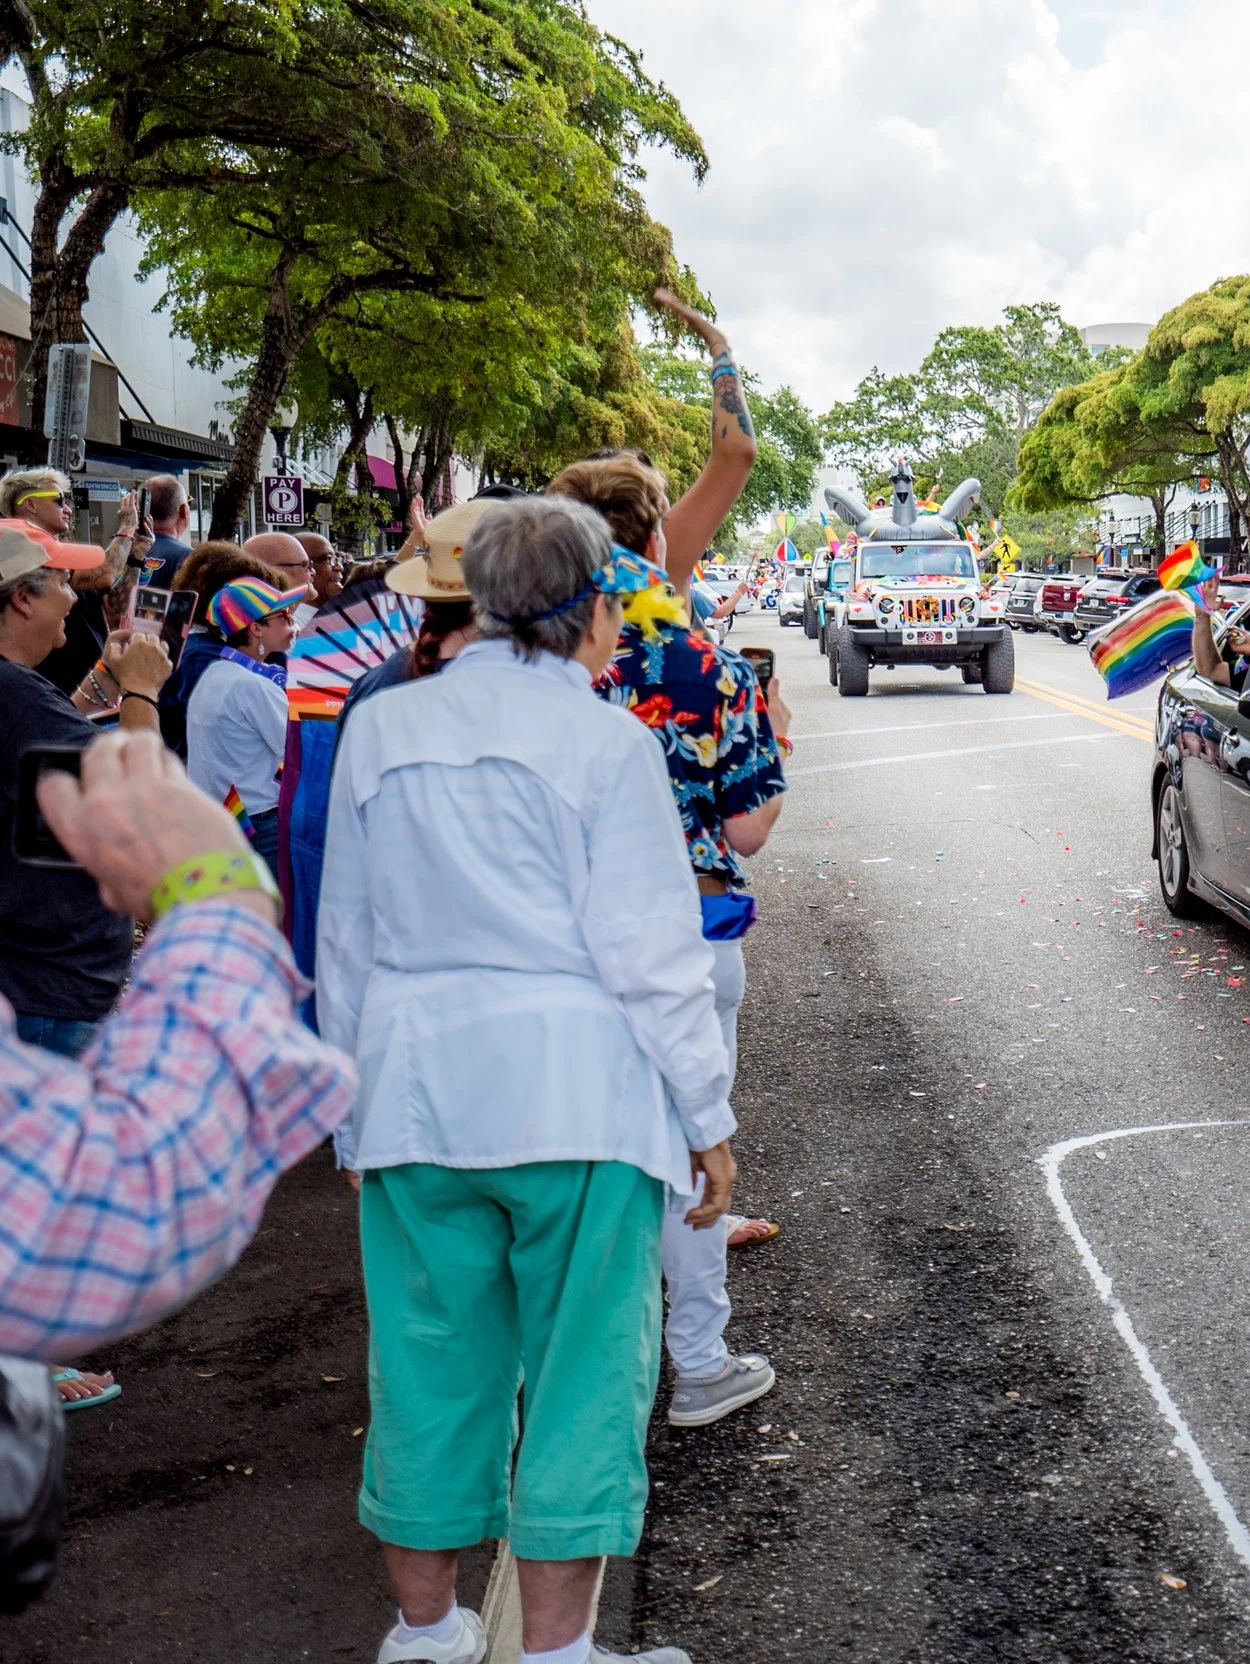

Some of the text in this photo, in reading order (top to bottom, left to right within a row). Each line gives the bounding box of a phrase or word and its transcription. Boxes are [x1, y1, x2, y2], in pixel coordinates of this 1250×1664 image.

[85, 482, 118, 490] SHWINCO
[270, 478, 296, 488] PAY
[277, 492, 291, 509] P
[267, 512, 301, 522] HERE
